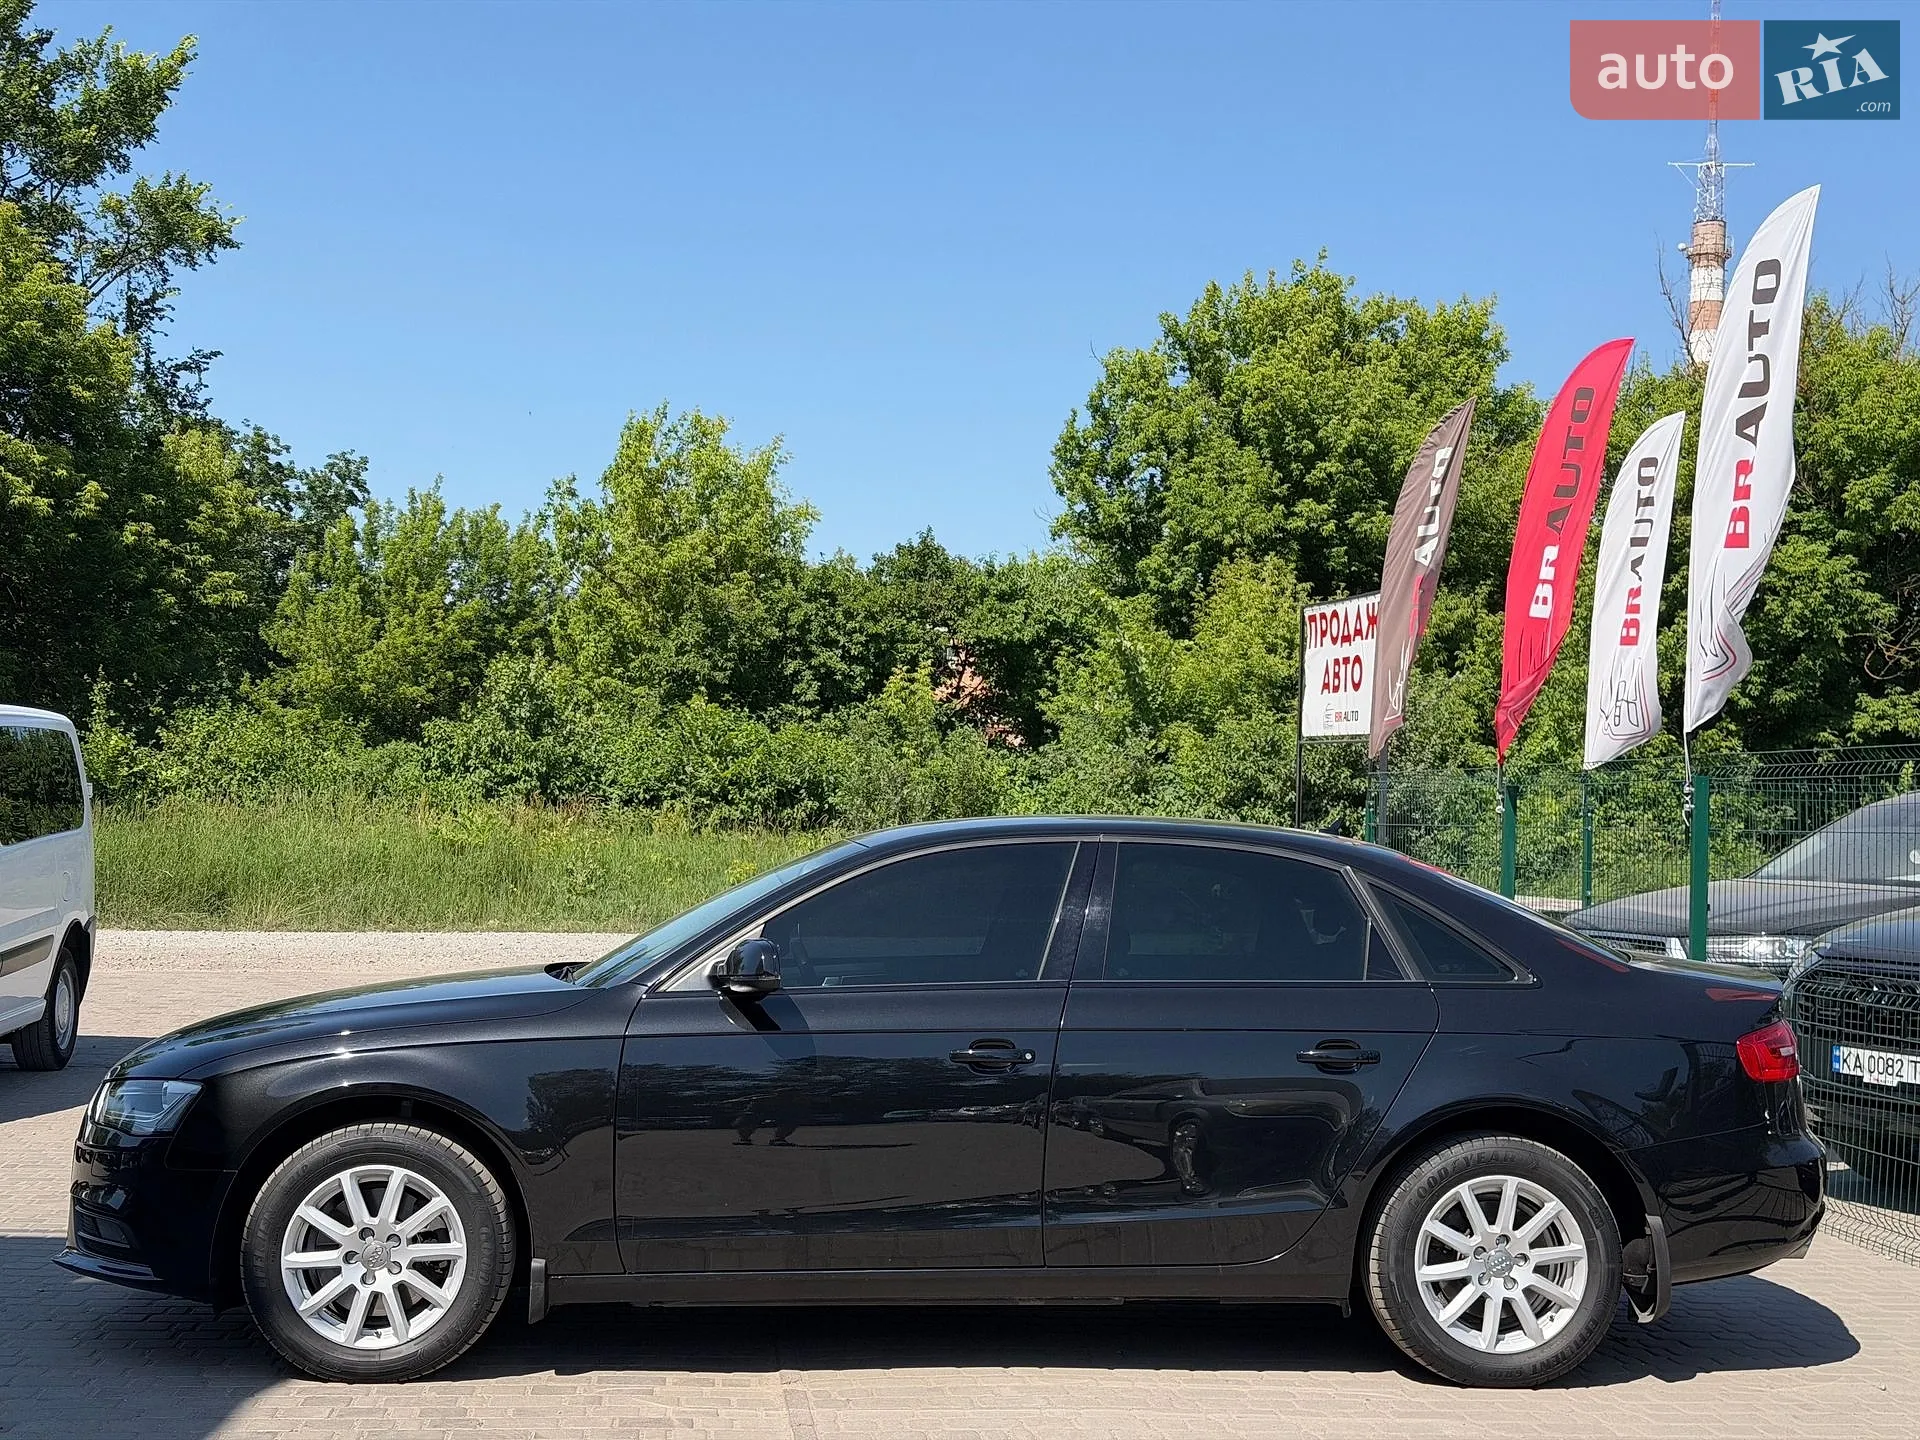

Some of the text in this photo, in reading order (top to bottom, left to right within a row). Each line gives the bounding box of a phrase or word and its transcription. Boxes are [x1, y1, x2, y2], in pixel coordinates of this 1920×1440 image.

[1321, 654, 1363, 695] АВТО
[1842, 1051, 1863, 1073] KA
[1868, 1055, 1904, 1078] 0082
